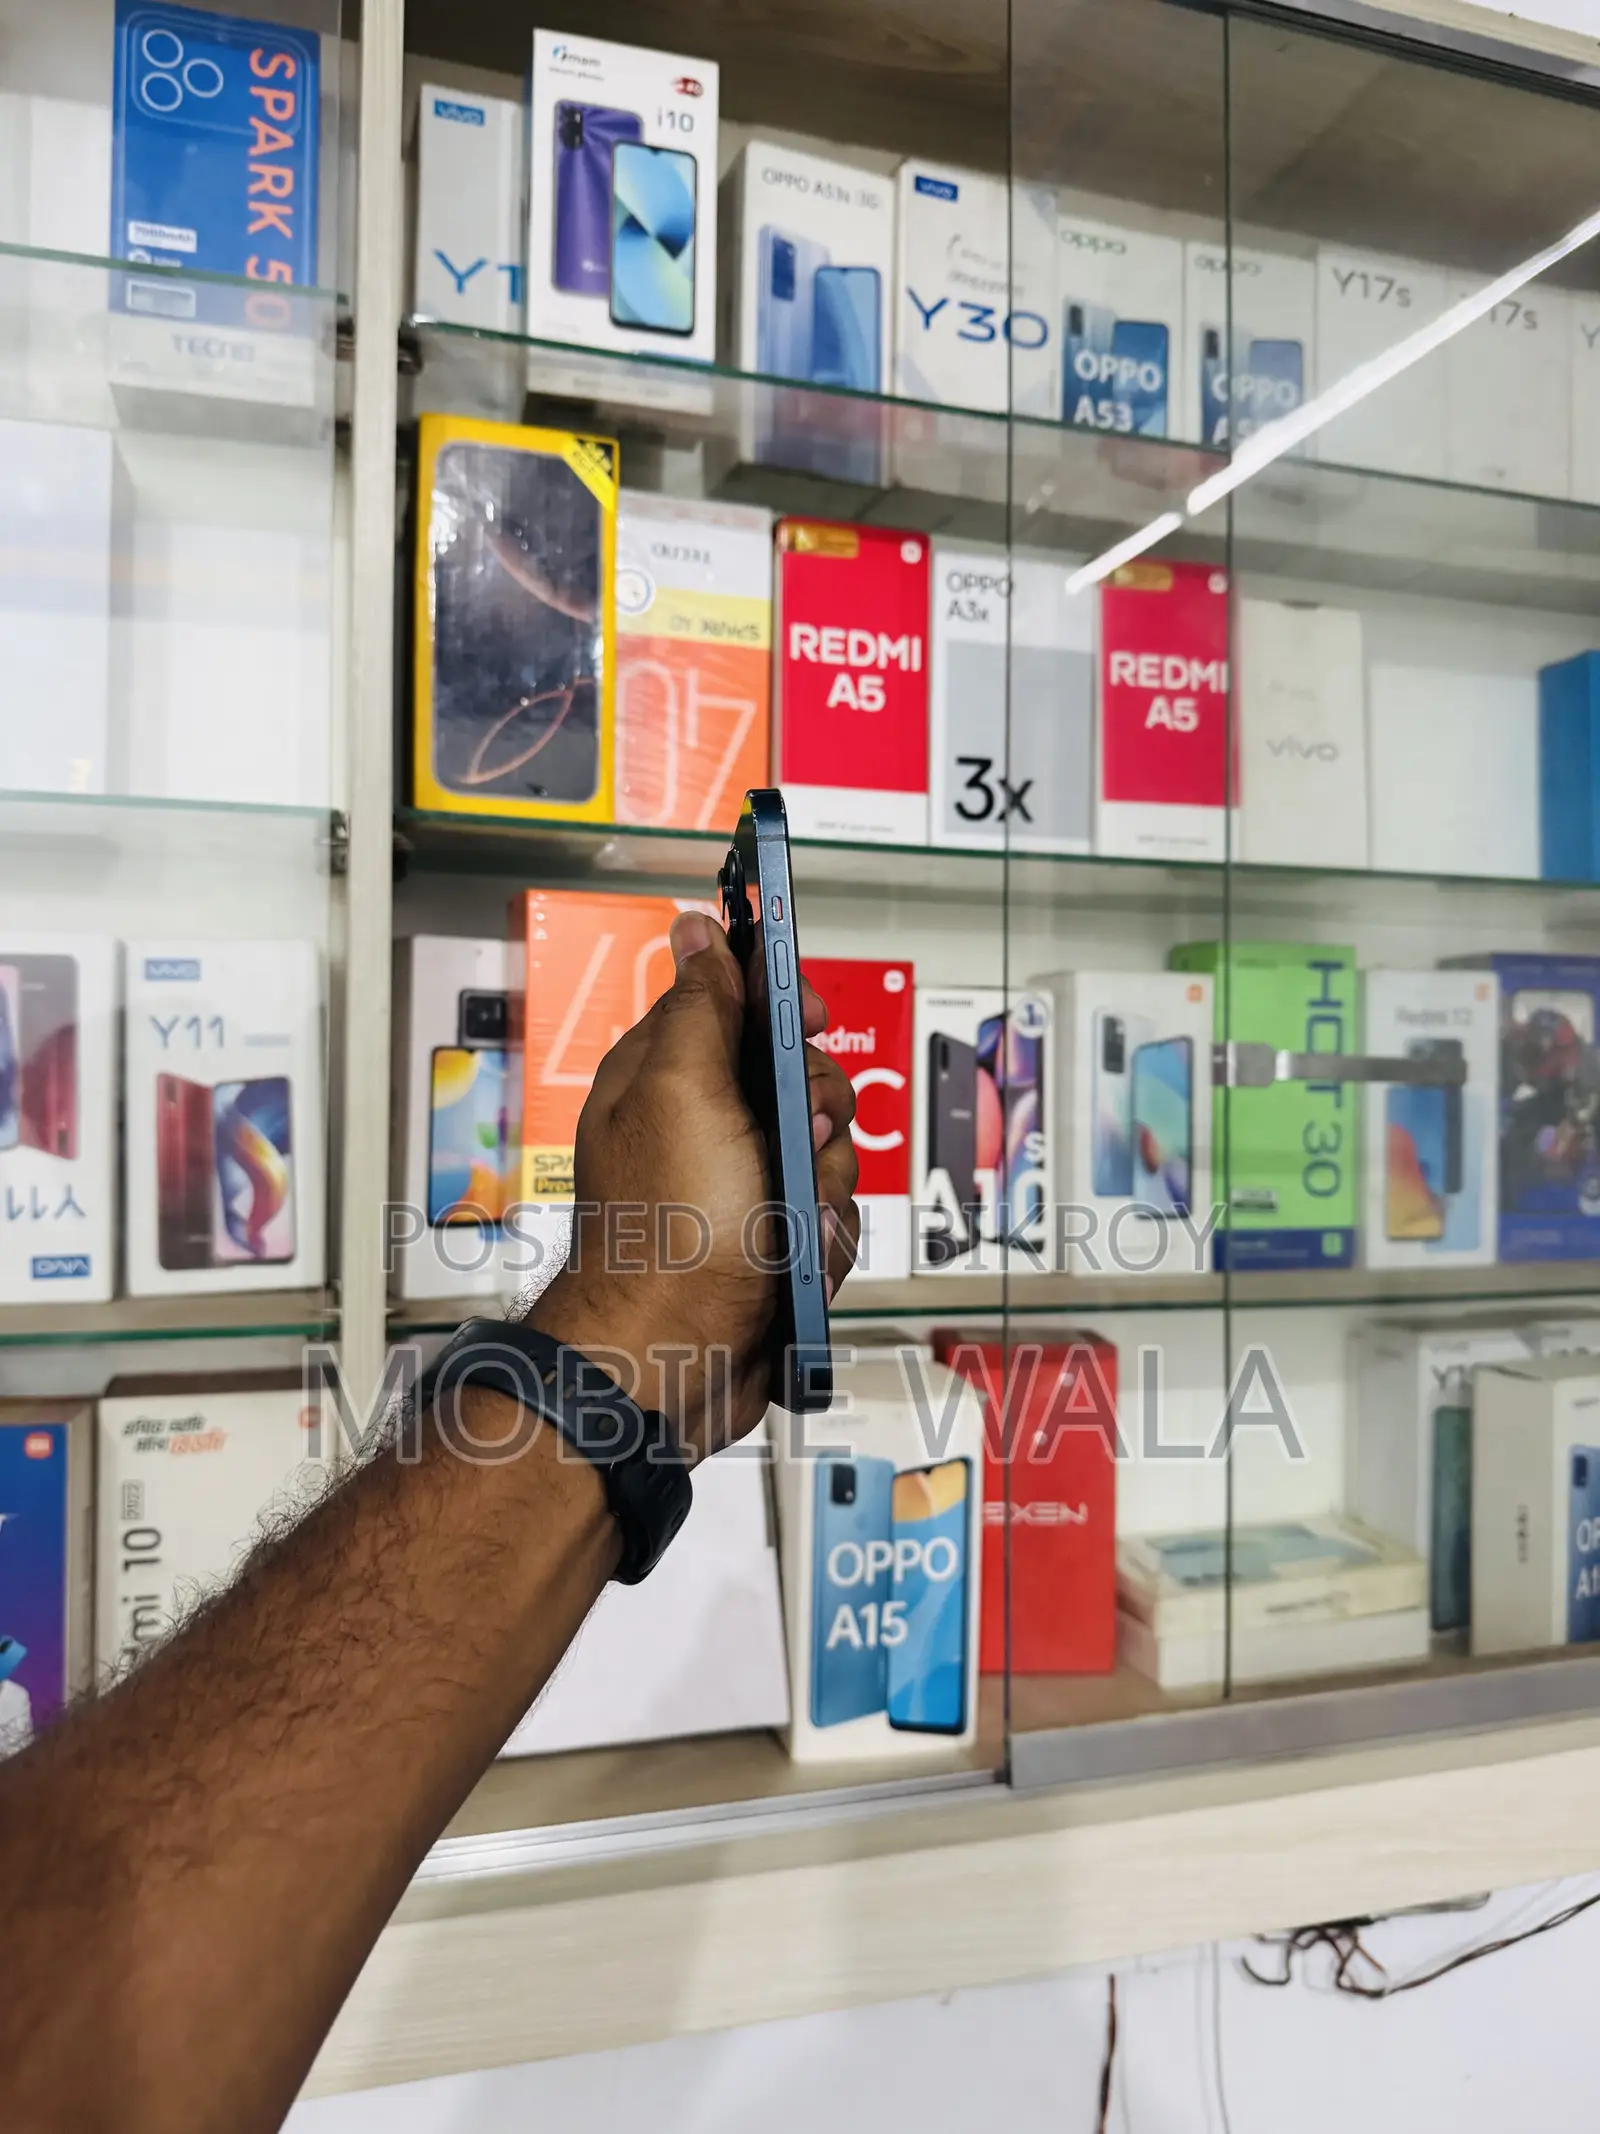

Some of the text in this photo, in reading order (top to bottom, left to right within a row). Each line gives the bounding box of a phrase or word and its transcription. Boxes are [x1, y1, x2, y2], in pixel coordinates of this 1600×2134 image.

[657, 106, 695, 133] i10
[245, 47, 297, 328] SPARK 50
[761, 167, 811, 193] OPPO
[1333, 266, 1412, 308] Y17s
[905, 284, 1049, 350] Y30
[1073, 348, 1162, 393] OPPO
[1073, 394, 1134, 434] A53
[946, 571, 1014, 599] OPPO
[788, 621, 923, 673] REDMI
[826, 672, 887, 713] A5
[1109, 650, 1229, 693] REDMI
[1144, 694, 1199, 733] A5
[1266, 734, 1340, 764] vivo
[954, 756, 1034, 824] 3x
[149, 1014, 225, 1050] Y11
[808, 1026, 876, 1054] edmi
[1302, 1121, 1342, 1199] 30
[923, 1168, 1046, 1243] A10
[122, 1526, 162, 1573] 10
[826, 1536, 959, 1588] OPPO
[825, 1600, 909, 1651] A15
